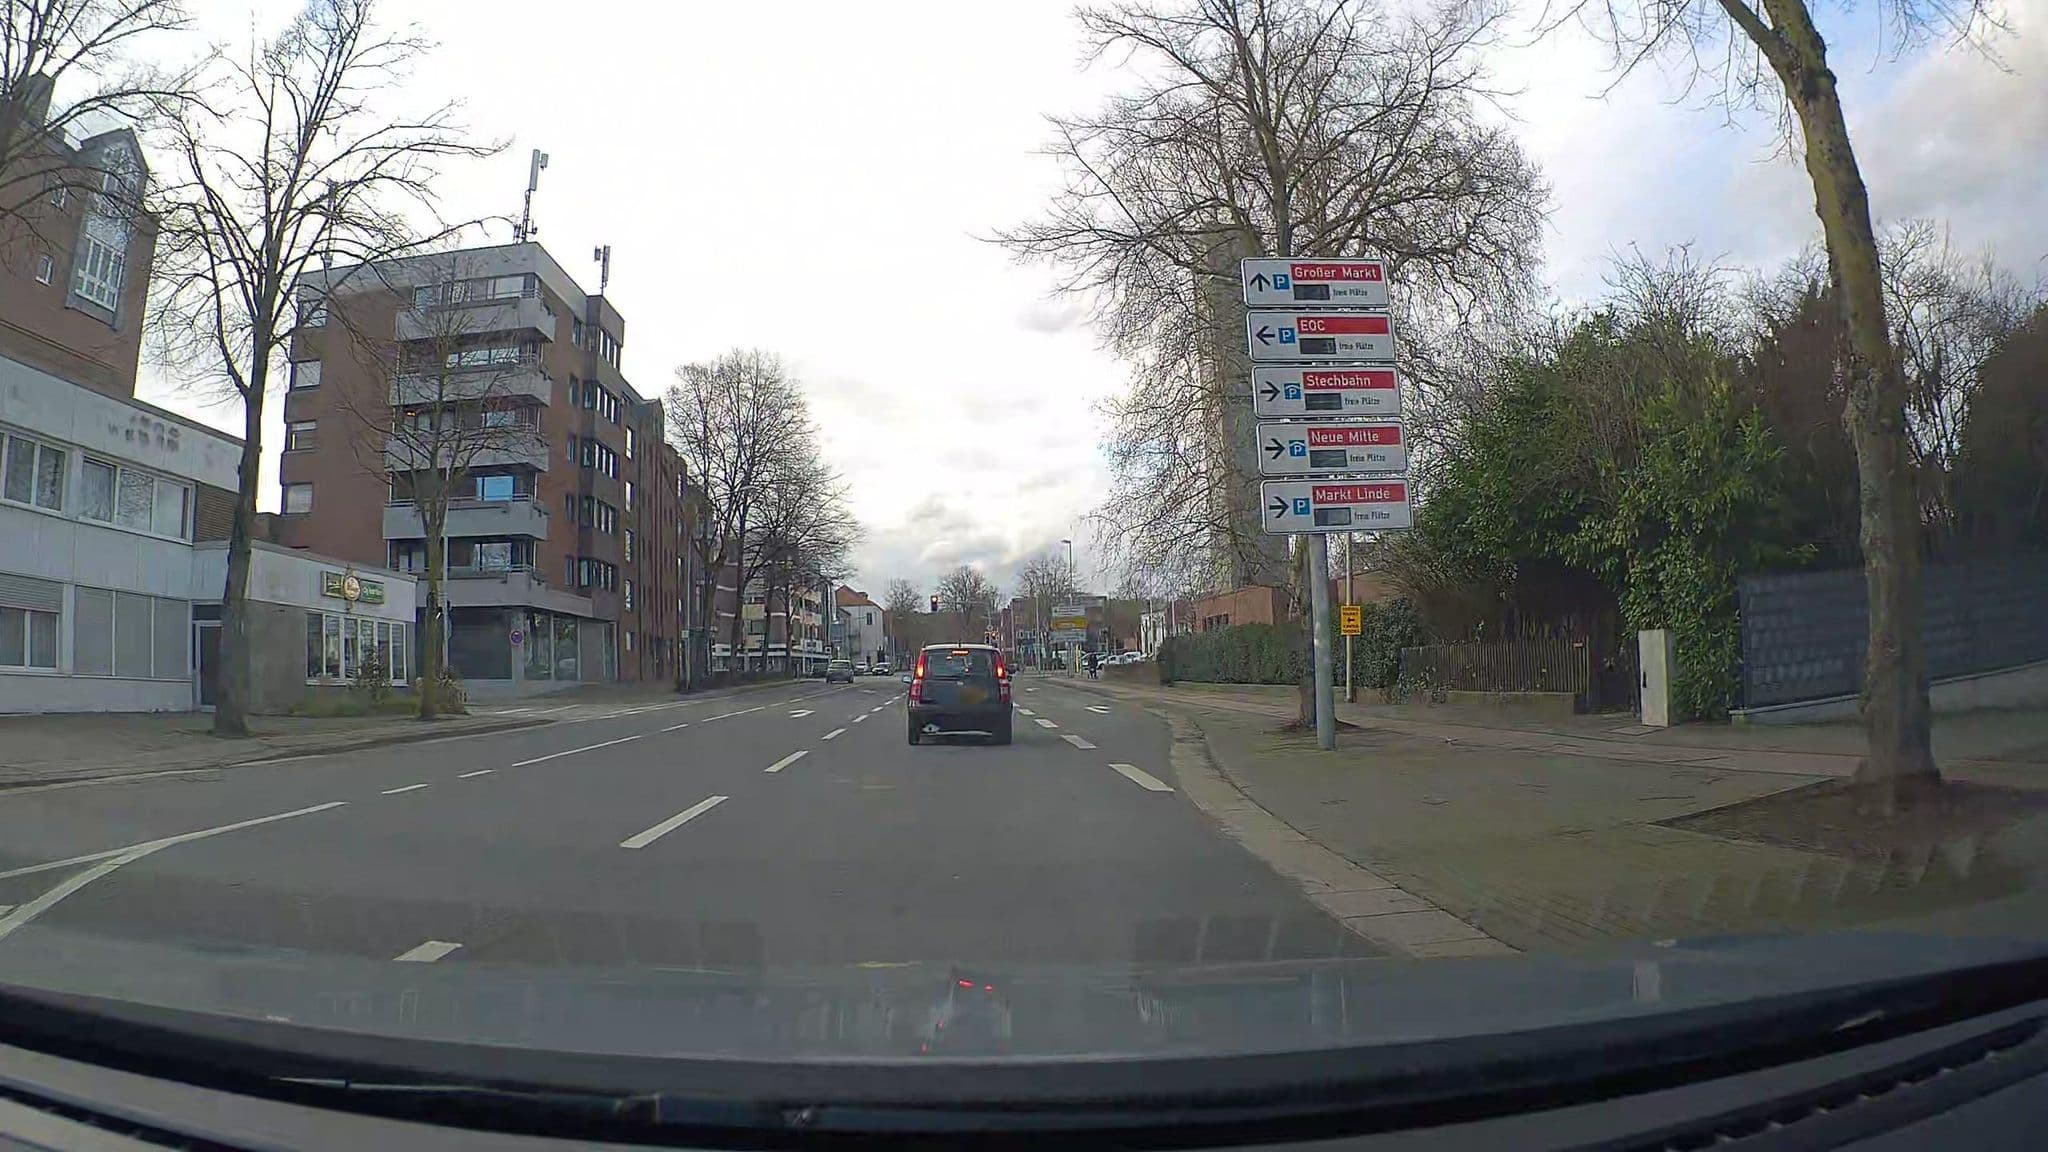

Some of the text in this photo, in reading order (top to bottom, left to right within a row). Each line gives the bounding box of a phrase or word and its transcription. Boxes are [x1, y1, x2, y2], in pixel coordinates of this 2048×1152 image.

[1294, 267, 1377, 278] Großer Markt
[1275, 275, 1286, 288] P
[1282, 329, 1292, 342] P
[1306, 374, 1371, 387] Stechbahn
[1311, 431, 1379, 443] Neue Mitte
[1316, 487, 1391, 501] Markt Linde
[1297, 501, 1306, 513] P
